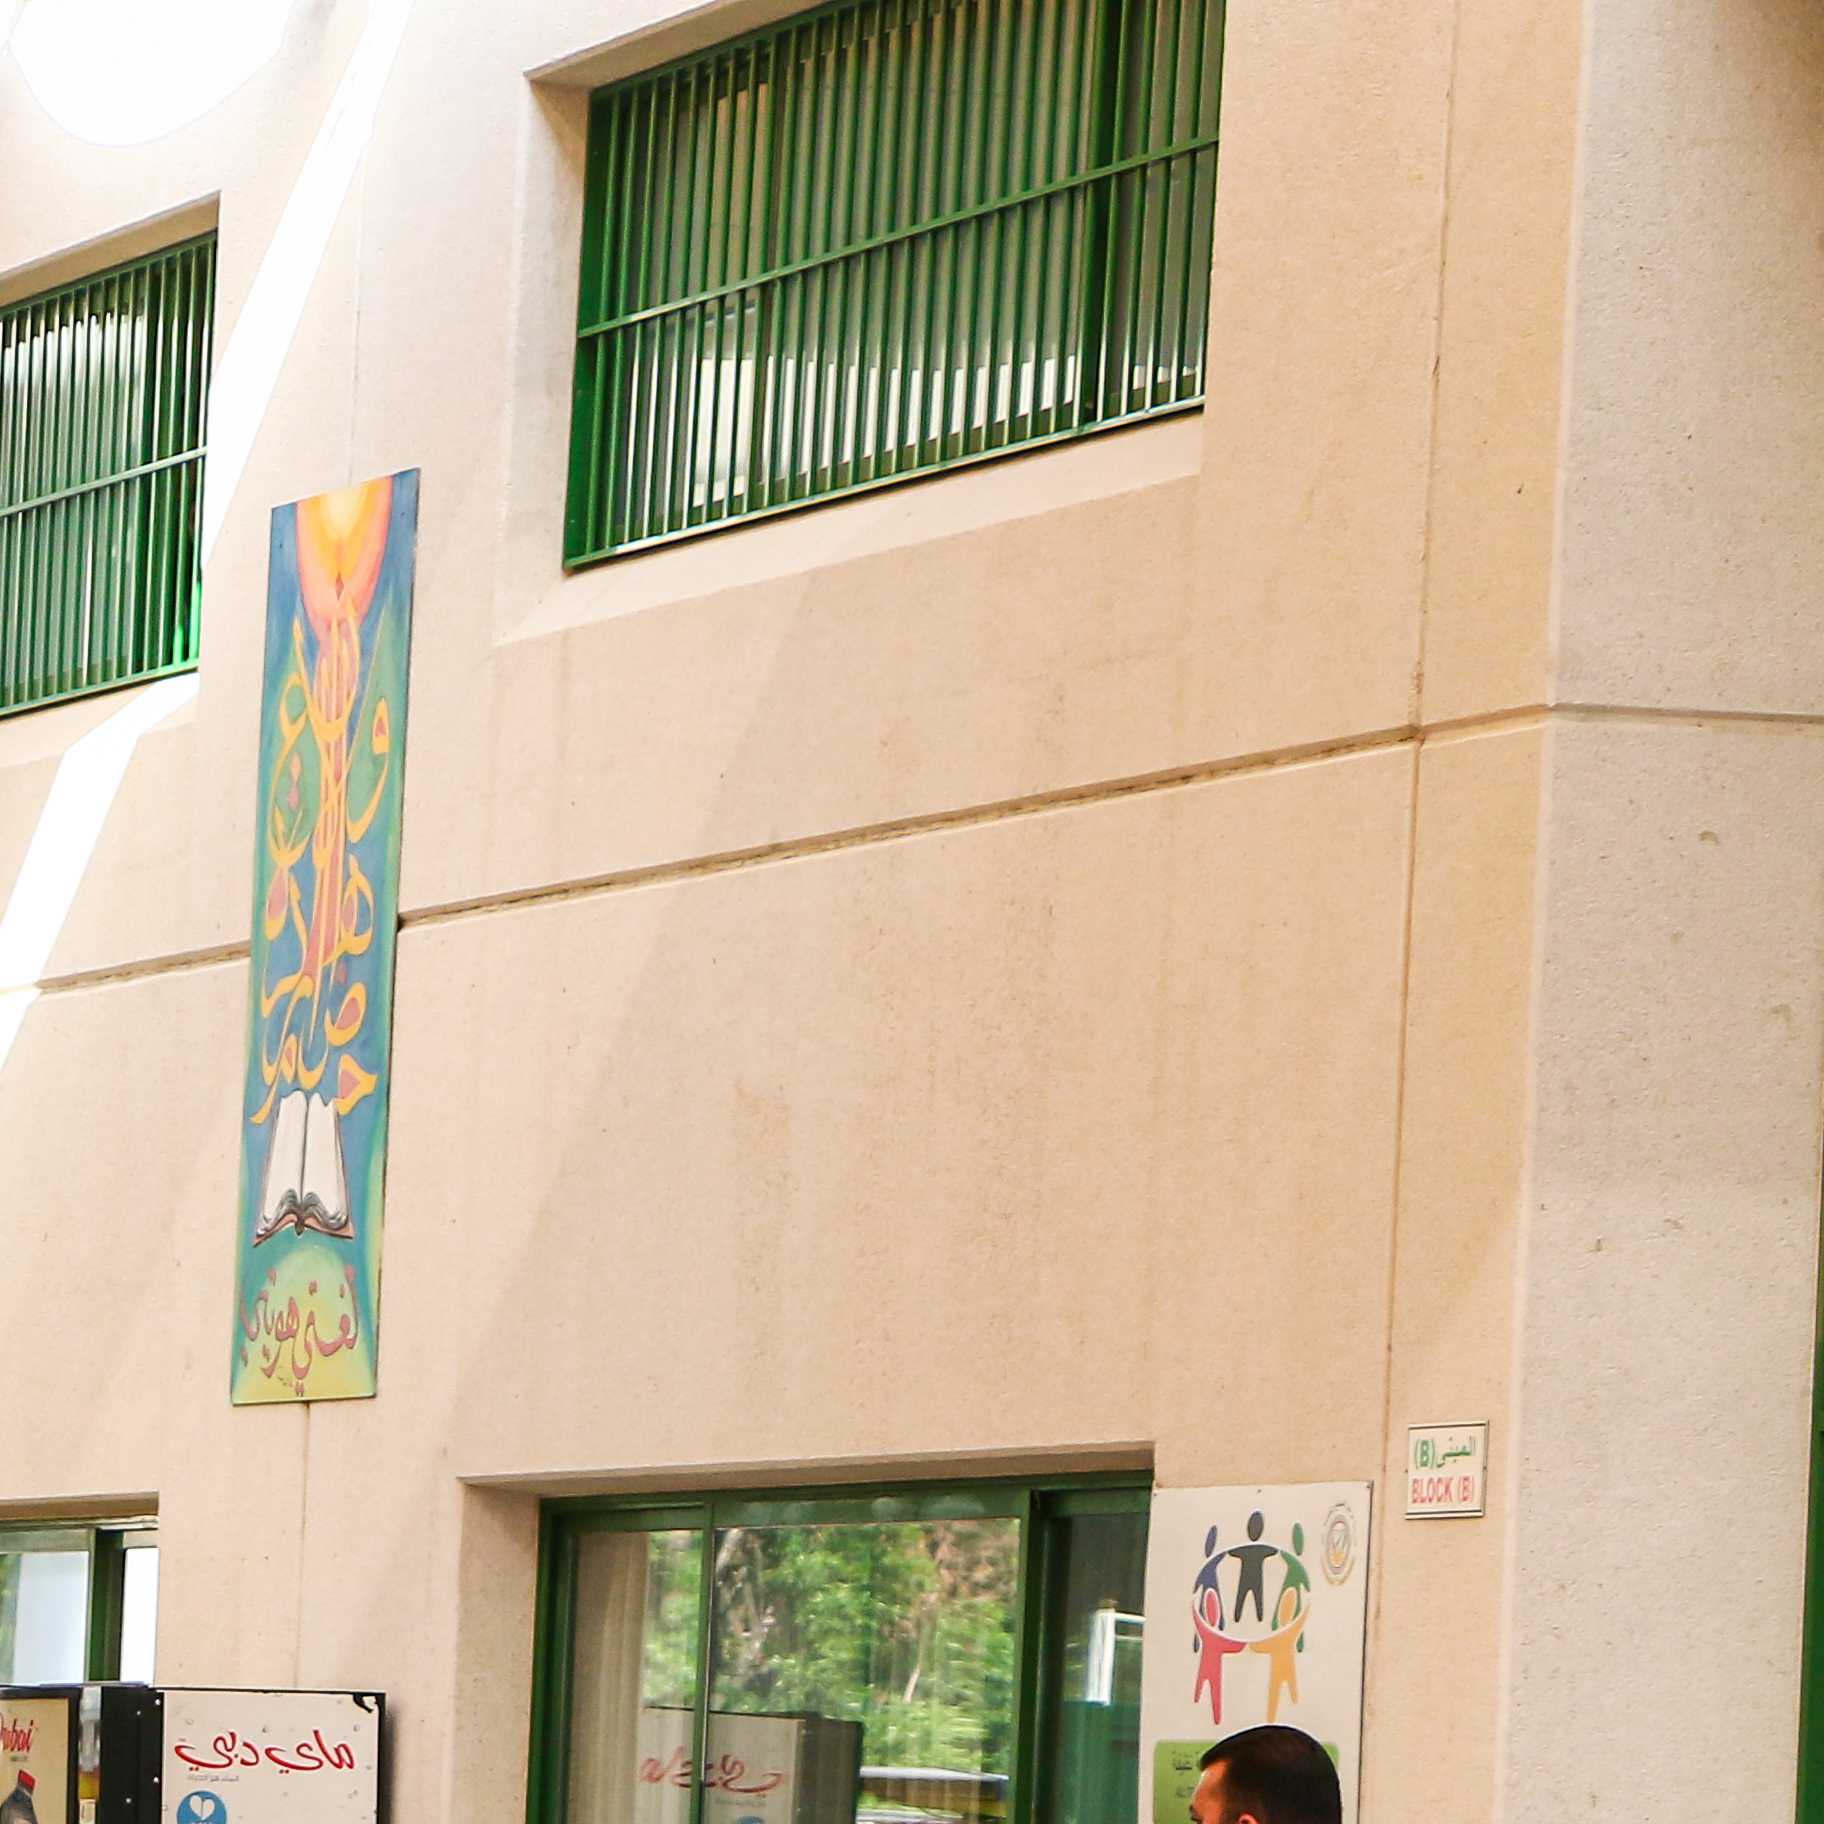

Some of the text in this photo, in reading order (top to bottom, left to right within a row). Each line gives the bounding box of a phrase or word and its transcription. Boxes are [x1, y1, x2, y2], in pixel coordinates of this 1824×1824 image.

[1412, 1477, 1453, 1504] BLOCK
[174, 1729, 355, 1775] ماي دبي
